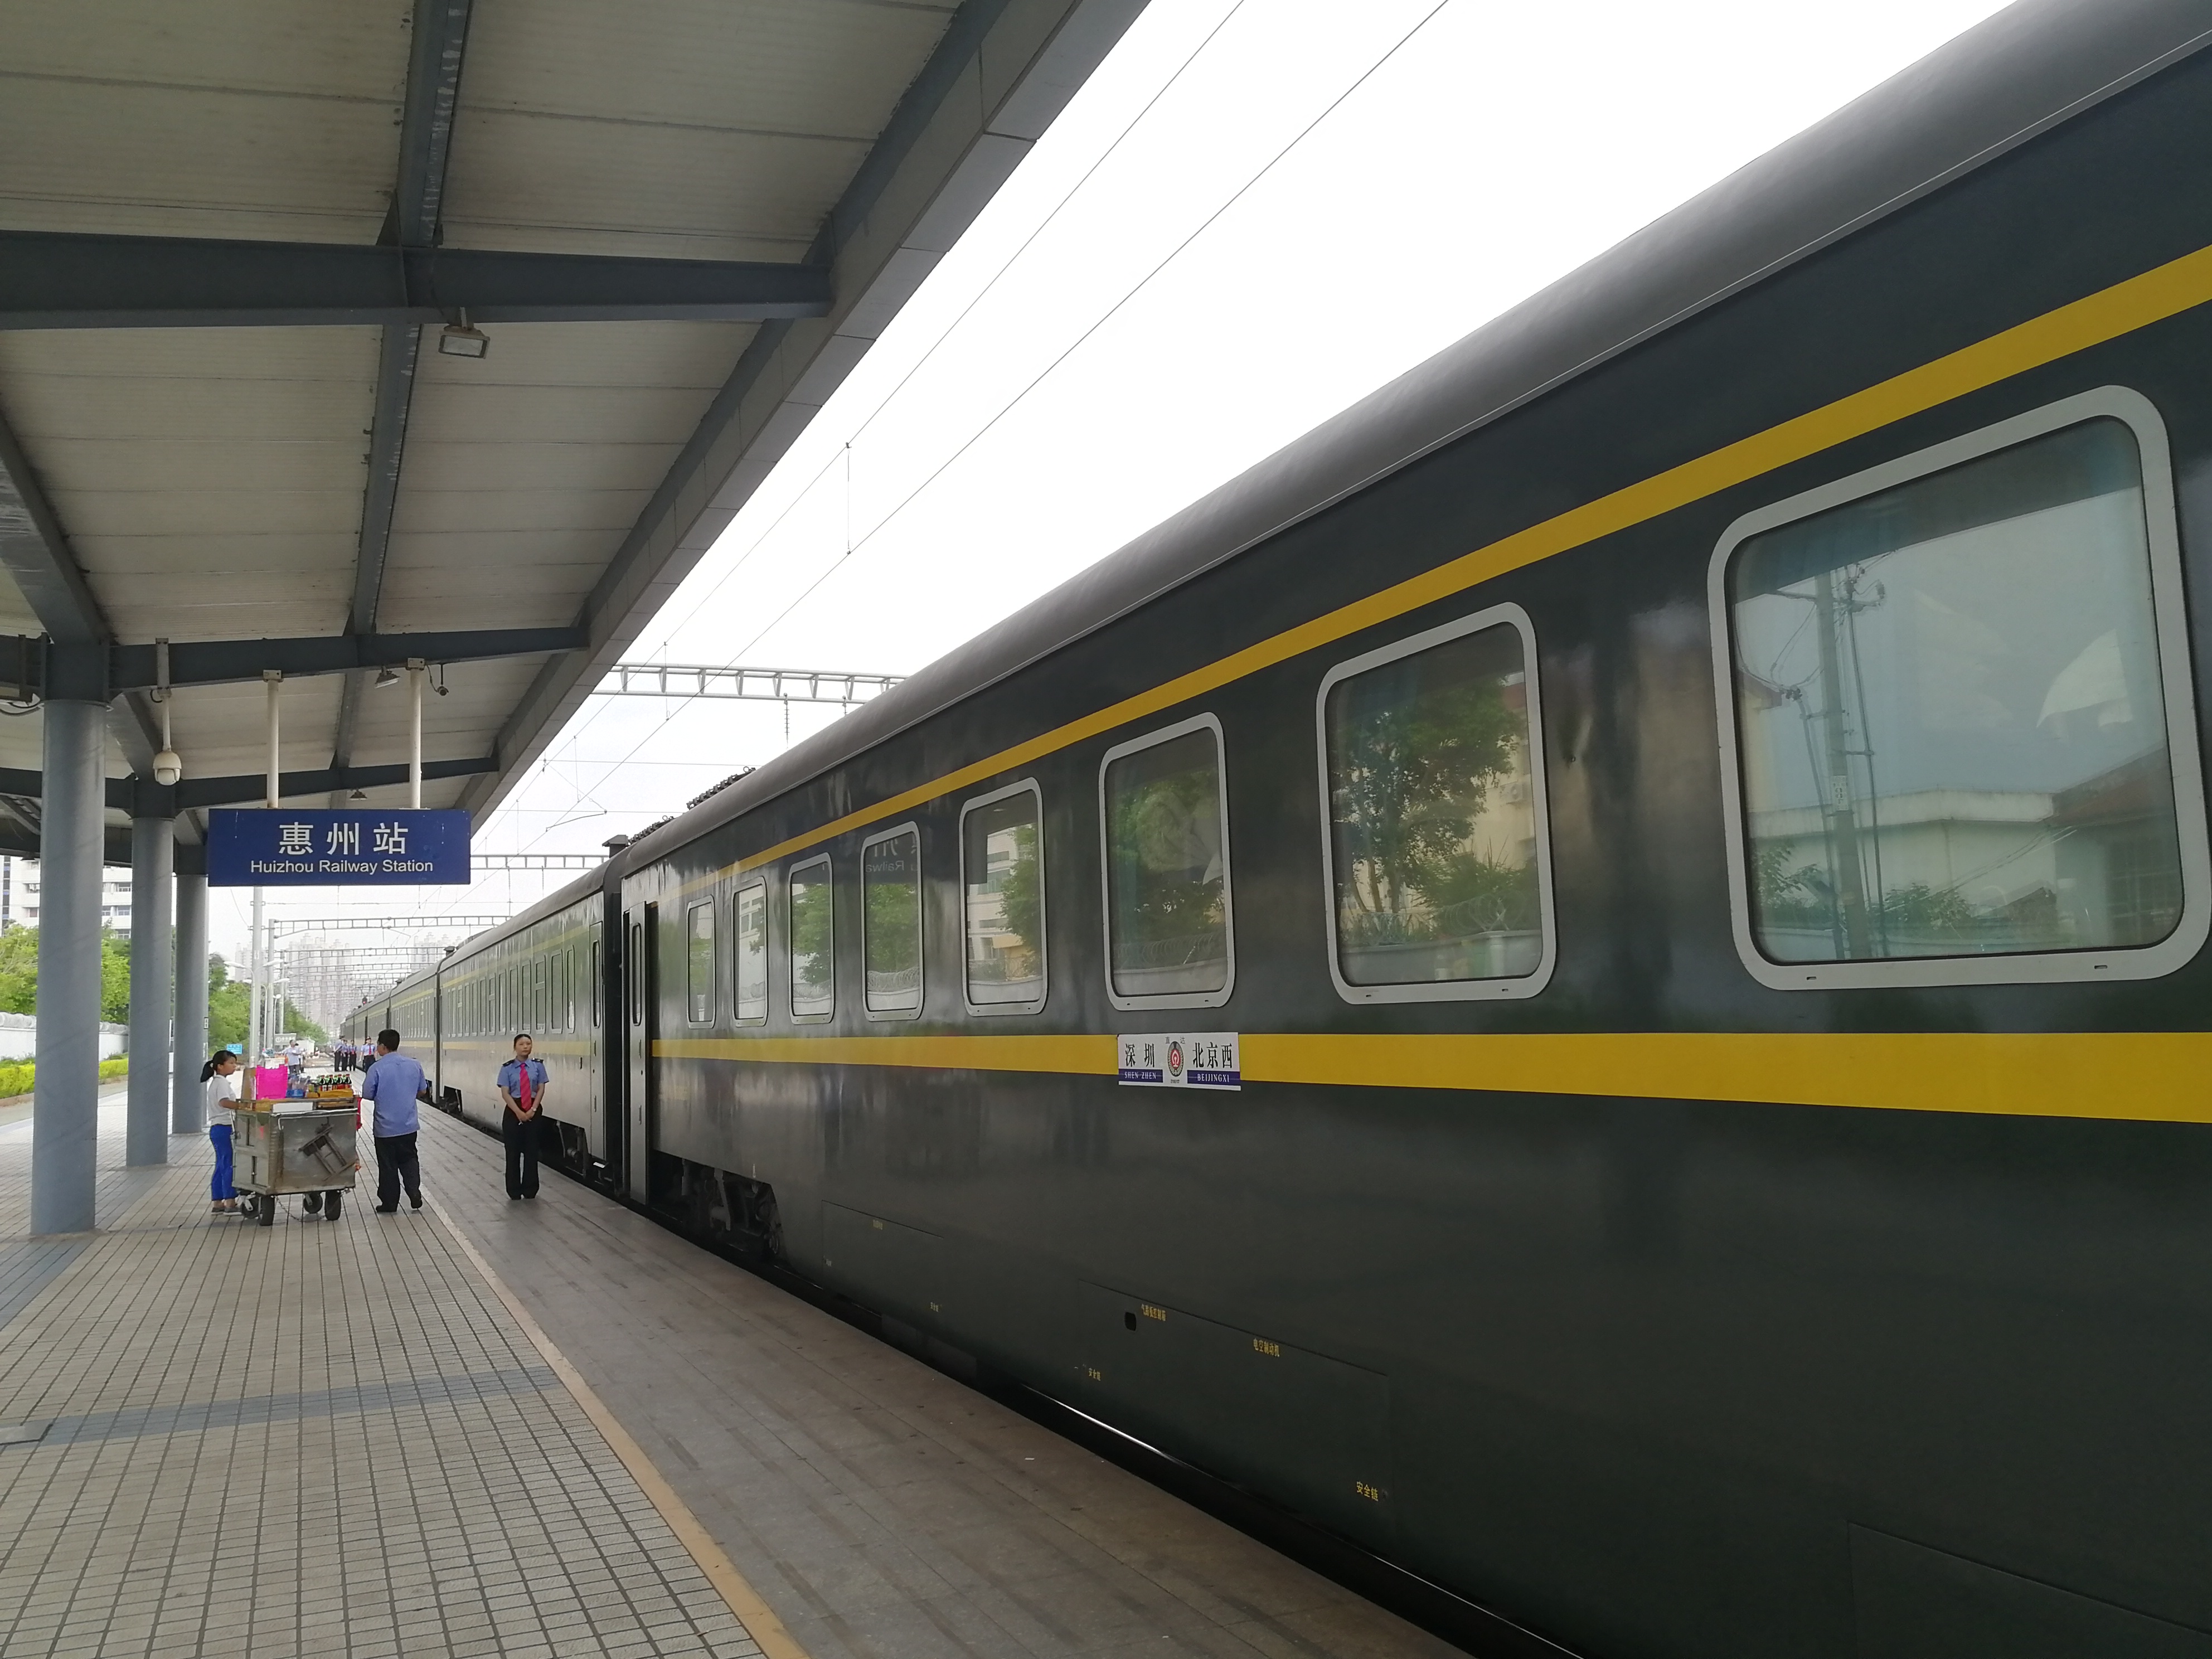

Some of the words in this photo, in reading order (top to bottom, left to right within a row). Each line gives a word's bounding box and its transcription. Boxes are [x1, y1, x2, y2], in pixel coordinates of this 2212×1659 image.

[279, 822, 408, 855] 惠州站
[251, 860, 314, 873] Huizhou
[319, 860, 377, 875] Railway
[382, 859, 433, 872] Station
[1125, 1043, 1154, 1068] 深圳
[1192, 1042, 1233, 1069] 北京西
[1197, 1074, 1230, 1083] BEIJINGXI
